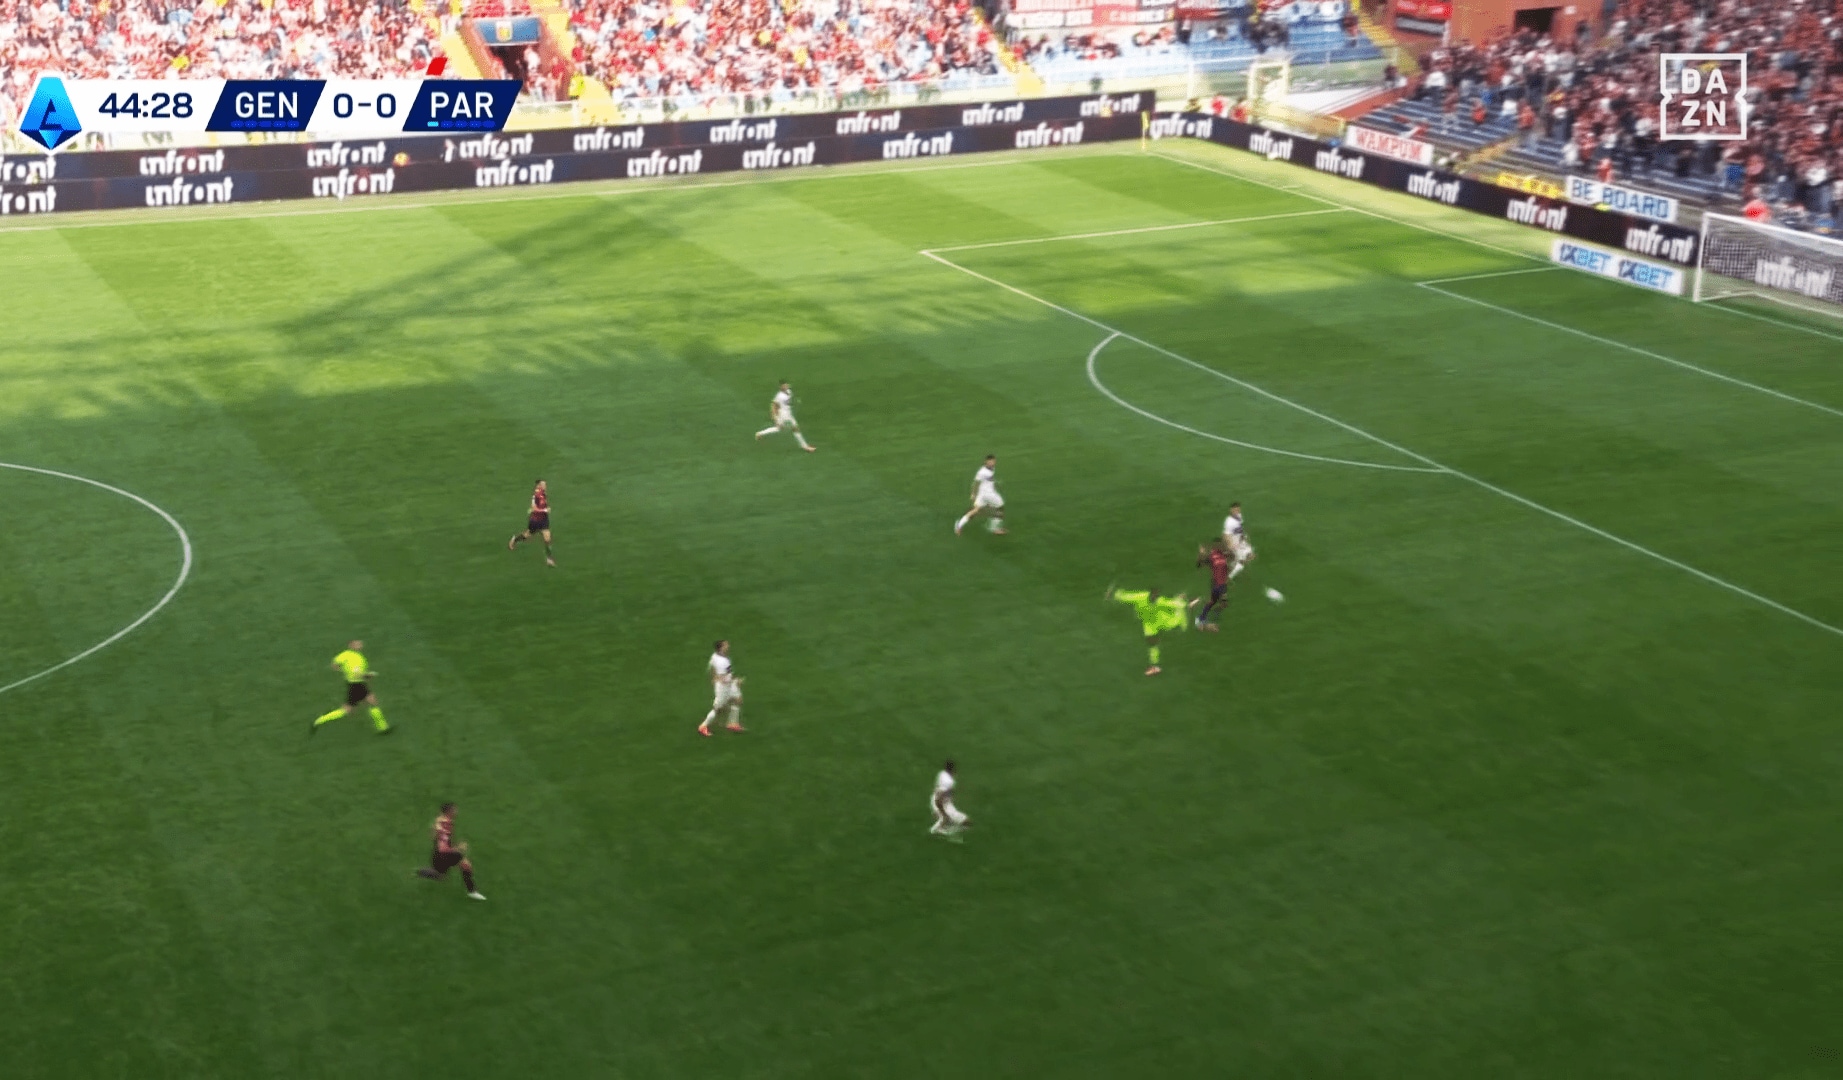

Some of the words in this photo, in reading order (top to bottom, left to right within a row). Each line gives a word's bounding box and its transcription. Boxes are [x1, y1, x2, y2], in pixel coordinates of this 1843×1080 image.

[836, 110, 902, 135] infront
[962, 101, 1025, 127] infront
[573, 126, 645, 152] infront
[710, 118, 778, 144] infront
[882, 131, 954, 159] infront
[1015, 121, 1085, 149] infront
[627, 149, 703, 178] infront
[742, 141, 816, 170] infront
[476, 159, 554, 188] infront
[1408, 170, 1461, 205] infront
[1572, 178, 1595, 201] BE
[1602, 186, 1672, 219] BOARD
[1507, 195, 1568, 232] infront
[1625, 224, 1695, 264] infront
